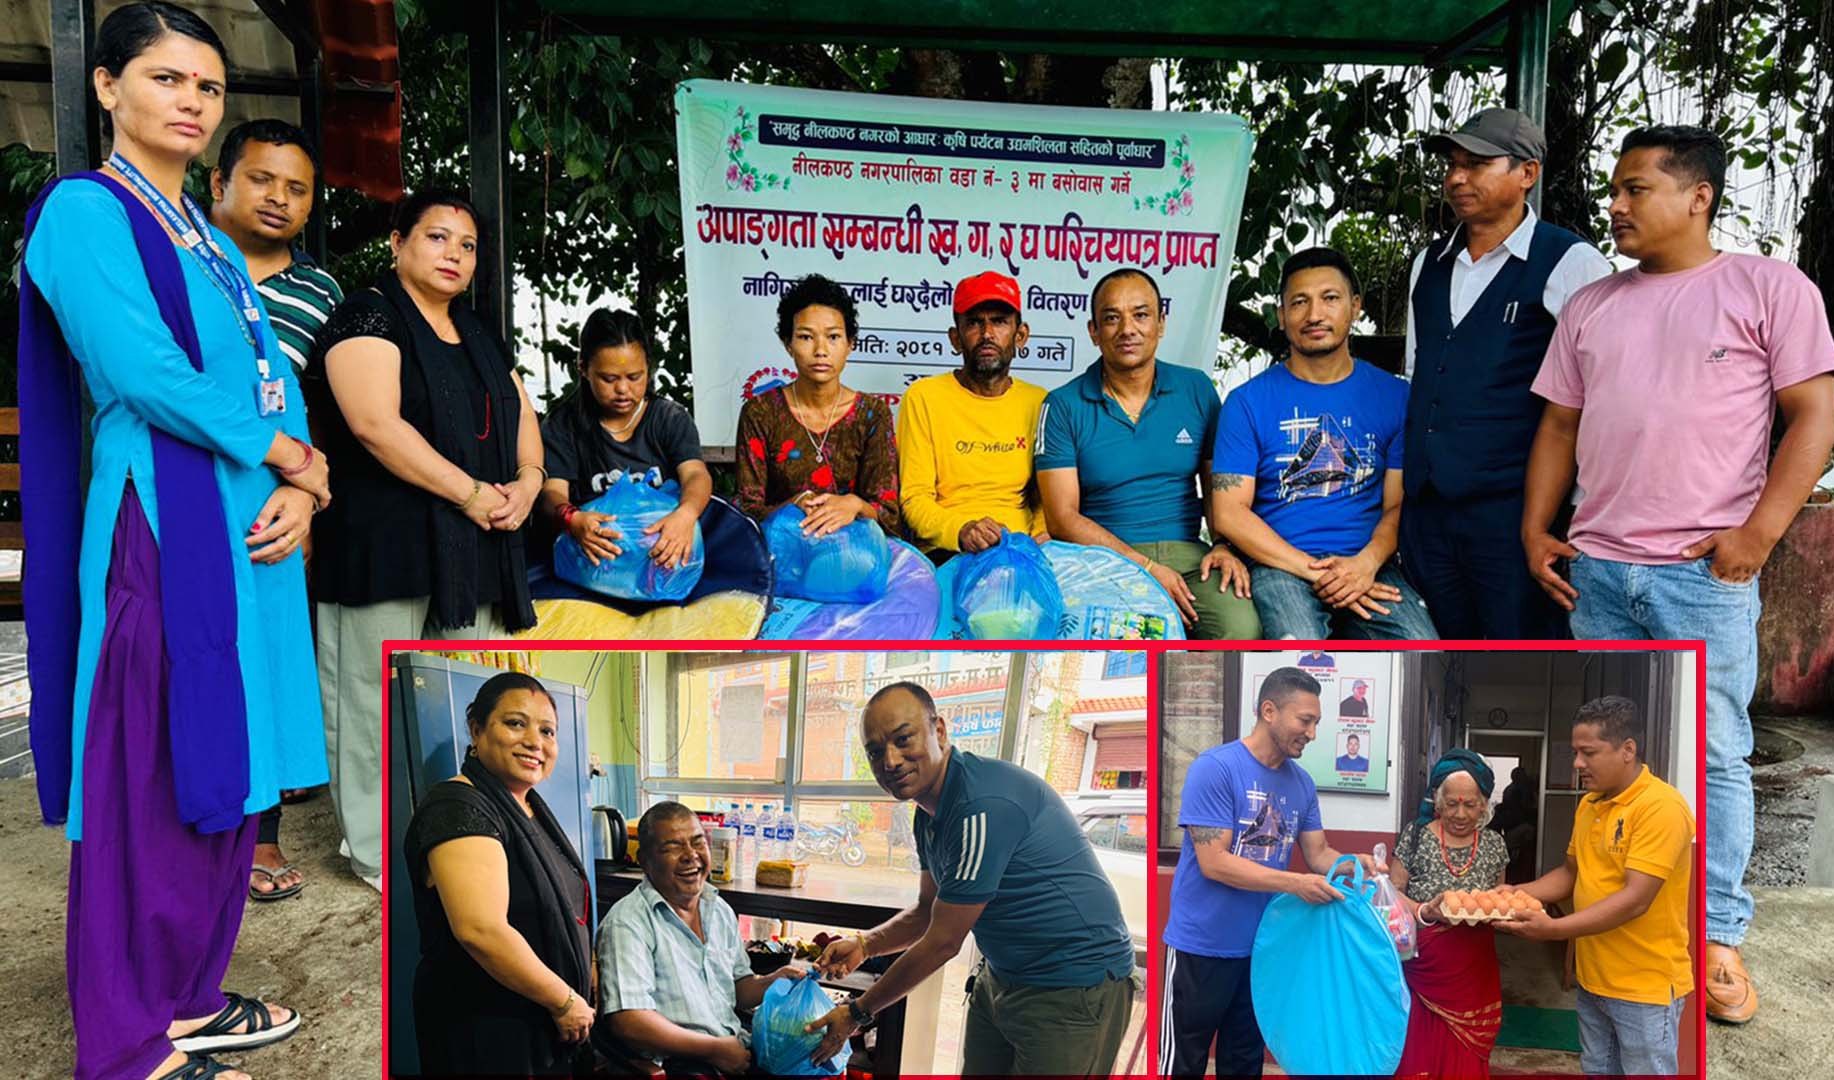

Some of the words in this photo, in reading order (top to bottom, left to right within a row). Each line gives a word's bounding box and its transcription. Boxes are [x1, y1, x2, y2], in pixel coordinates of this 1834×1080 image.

[803, 120, 856, 141] नीलकण्ठ
[858, 126, 900, 143] नगरको
[943, 131, 966, 151] कृषि
[970, 133, 1003, 151] पर्यटन
[1070, 138, 1113, 157] सहितको
[792, 151, 854, 179] नीलकण्ठ
[860, 158, 943, 185] नगरपालिका
[949, 167, 977, 188] वडा
[1010, 171, 1019, 193] ३
[1028, 171, 1046, 190] मा
[1052, 169, 1104, 195] बसोवास
[696, 204, 818, 261] अपाङ्गता
[822, 203, 924, 260] सम्बन्धी
[928, 219, 962, 265] ख,
[968, 220, 993, 260] ग,
[1044, 211, 1163, 279] परिचयपत्र
[1162, 230, 1220, 275] प्राप्त
[891, 278, 954, 313] घरदैलो
[1027, 284, 1088, 320] वितरण
[896, 340, 942, 358] २०८१
[1037, 342, 1067, 360] गते
